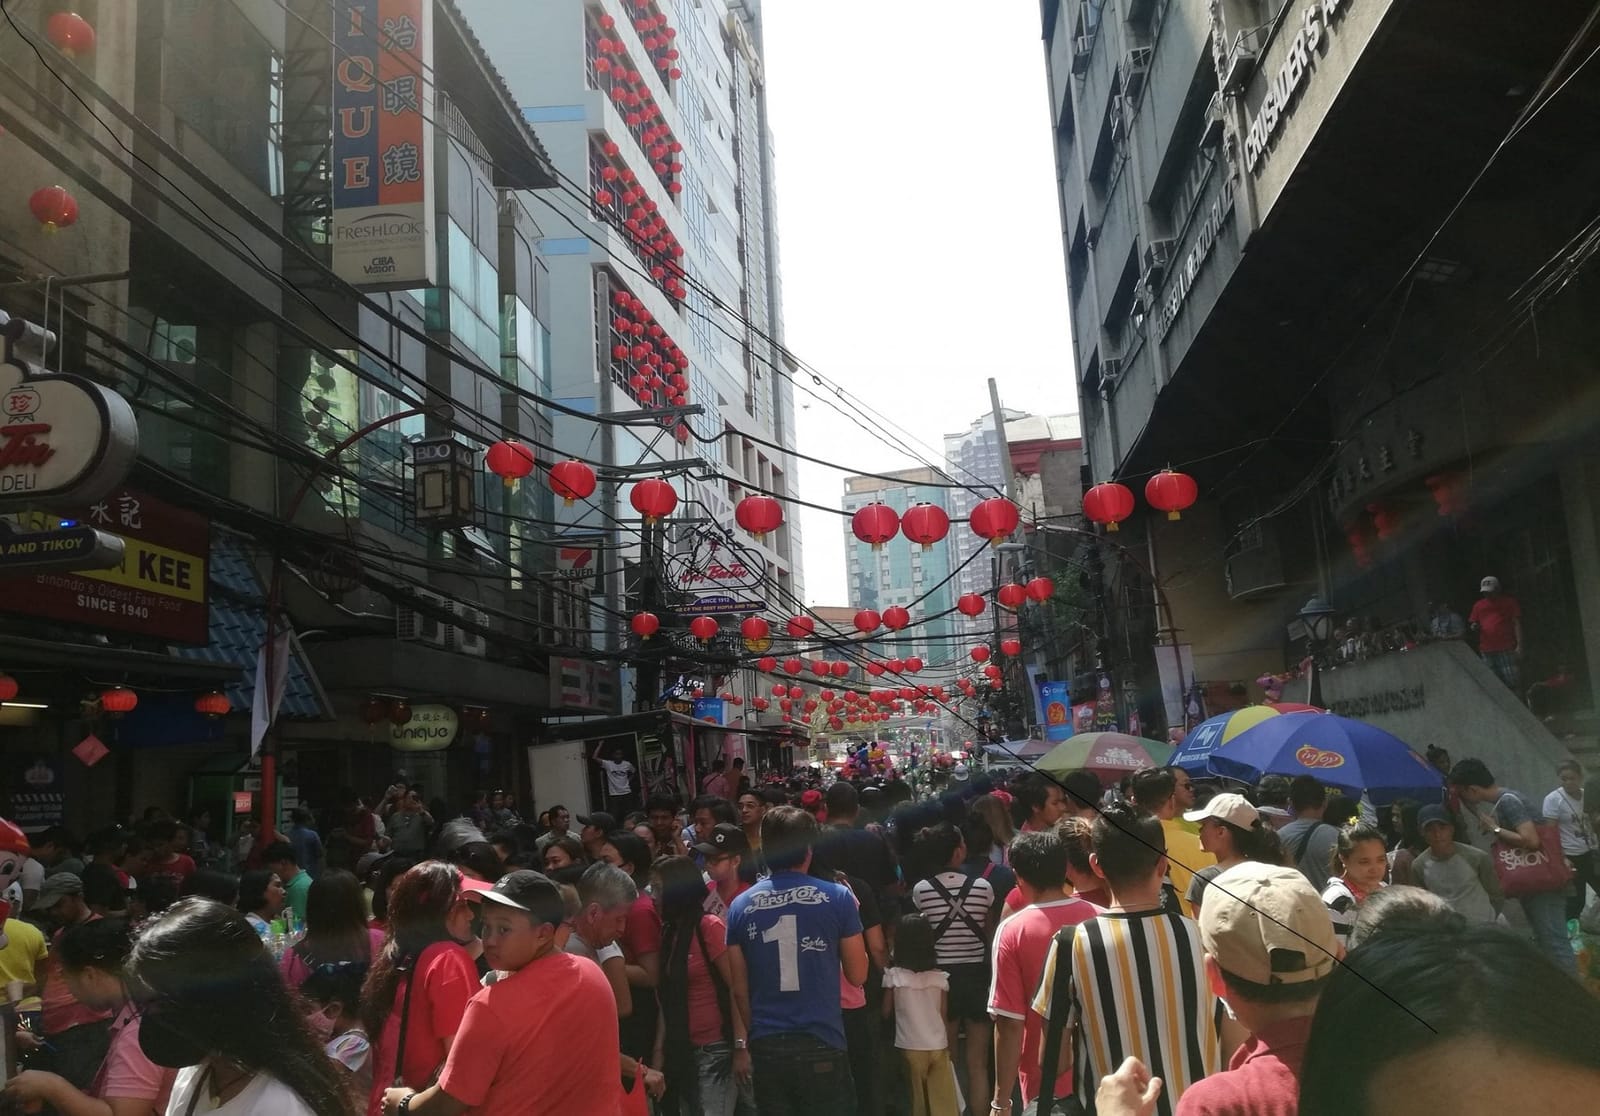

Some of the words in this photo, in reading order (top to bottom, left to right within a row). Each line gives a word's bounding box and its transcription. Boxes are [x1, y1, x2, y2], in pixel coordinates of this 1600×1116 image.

[416, 444, 451, 459] BDO
[2, 473, 37, 492] DELI
[8, 542, 37, 554] AND
[41, 537, 84, 552] TIKOY
[139, 550, 192, 591] KEE
[77, 594, 117, 613] SINCE
[121, 602, 149, 619] 1940
[1095, 755, 1146, 767] SUNTEX
